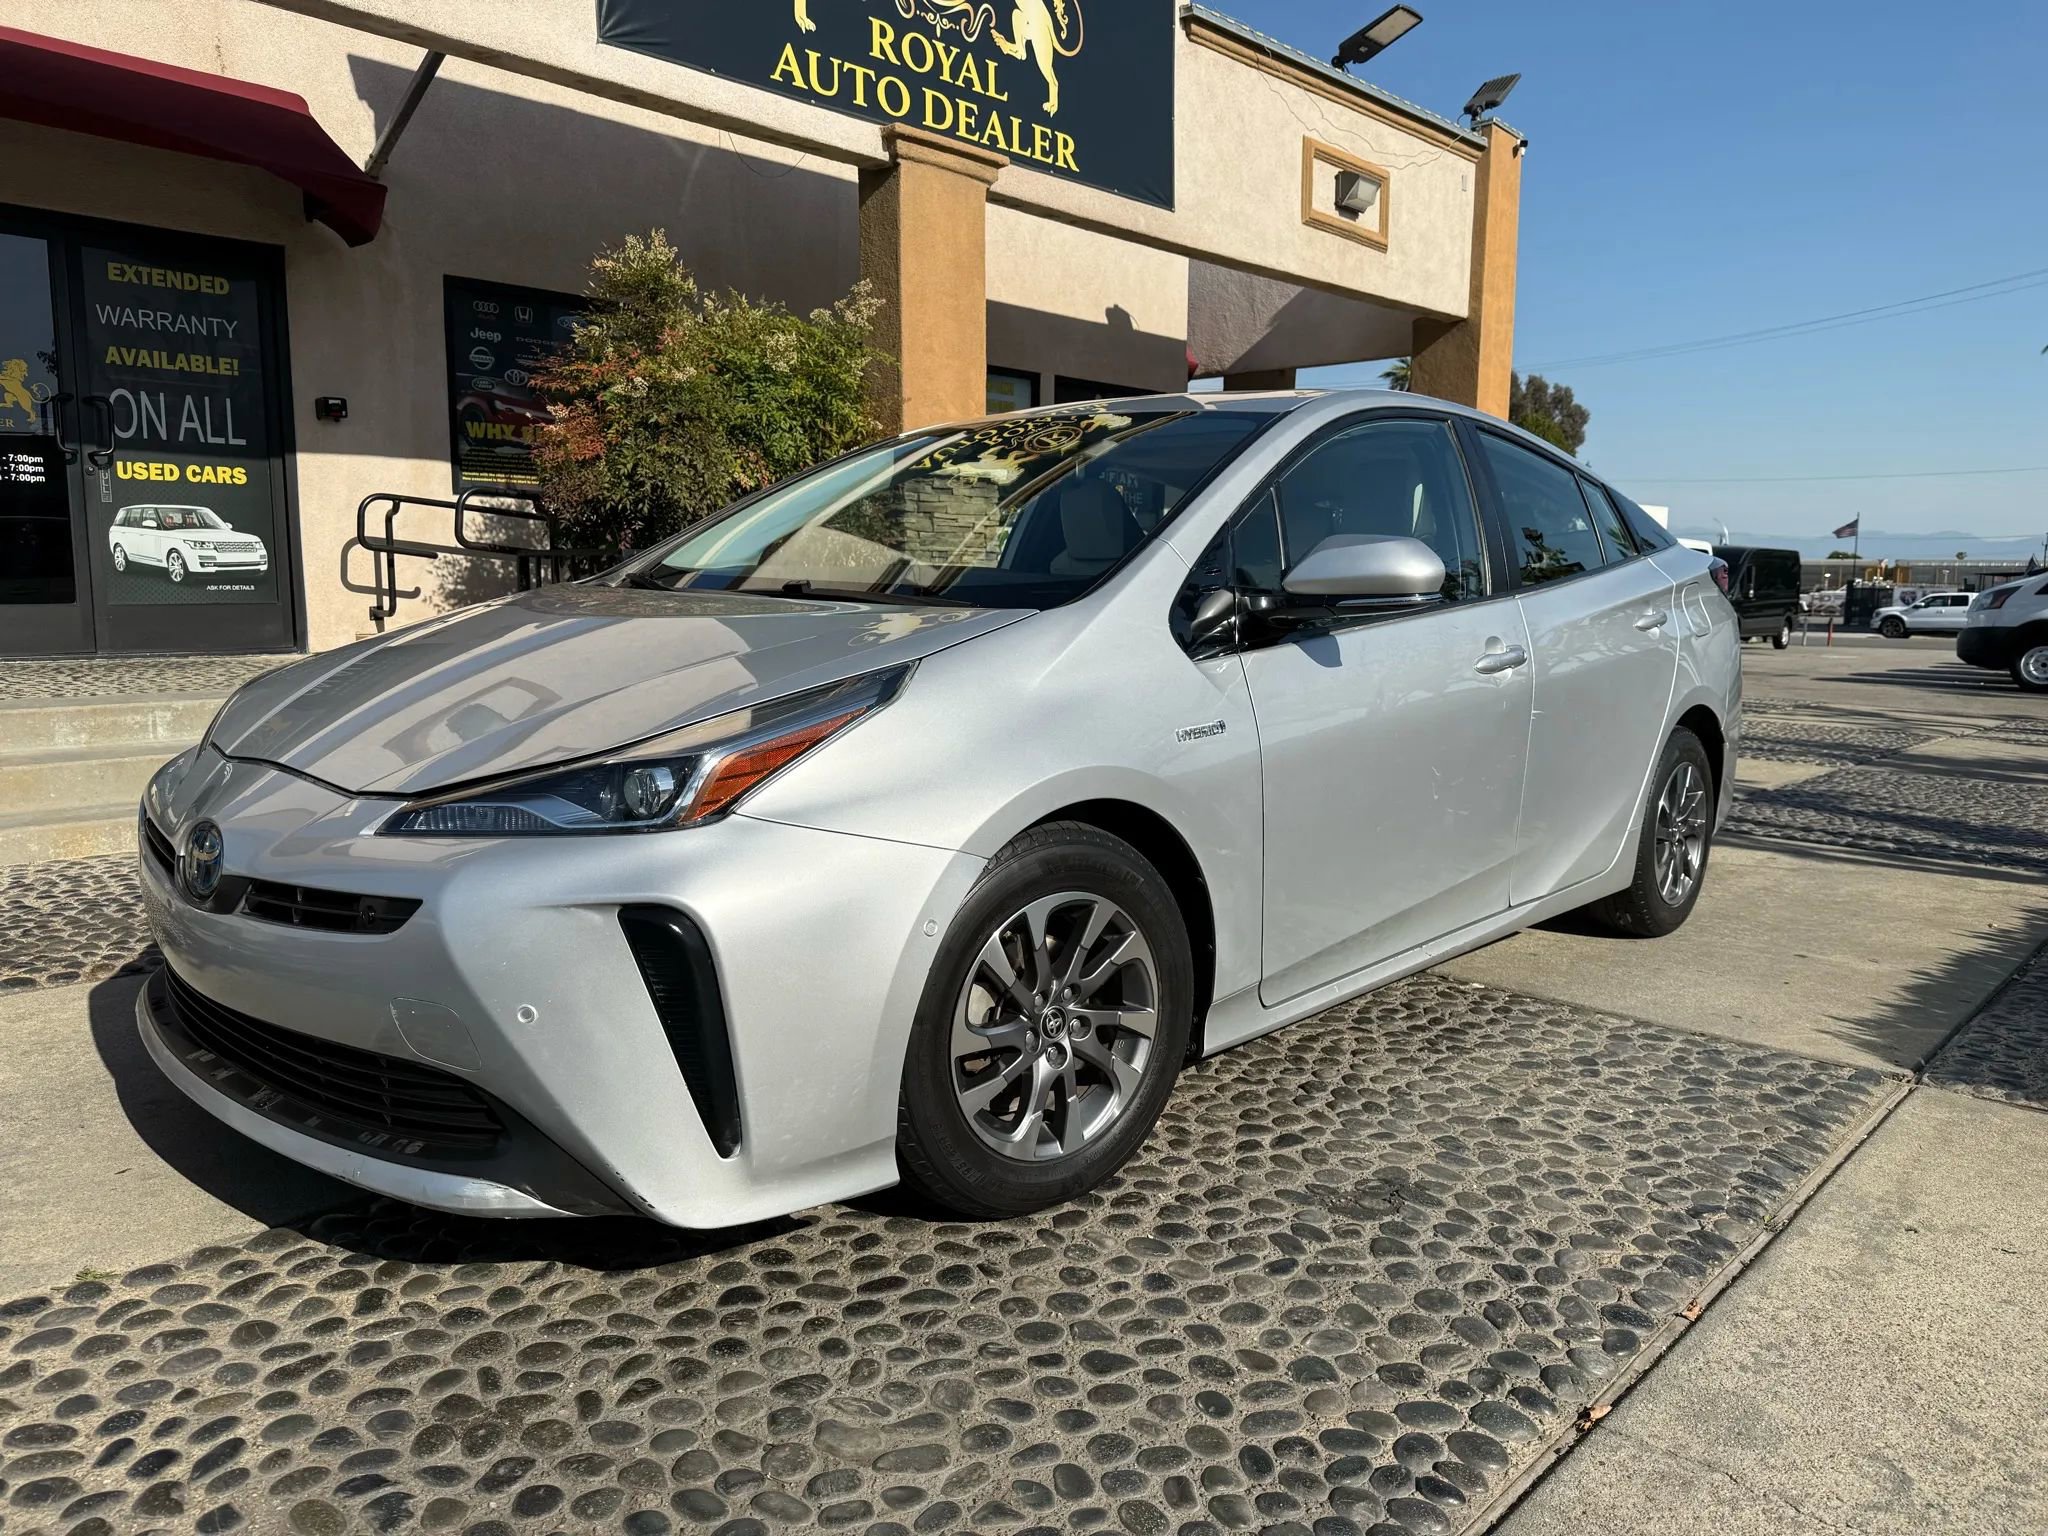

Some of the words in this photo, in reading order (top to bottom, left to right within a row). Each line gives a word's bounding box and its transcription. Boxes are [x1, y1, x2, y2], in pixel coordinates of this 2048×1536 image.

[868, 16, 1009, 102] ROYAL
[769, 42, 911, 118] AUTO
[921, 86, 1080, 173] DEALER
[107, 262, 230, 295] EXTENDED
[95, 303, 238, 339] WARRANTY
[470, 327, 502, 344] Jeep
[105, 345, 239, 376] AVAILABLE!
[108, 387, 168, 441] ON
[179, 395, 247, 446] ALL
[465, 421, 516, 440] WHY
[7, 453, 44, 464] 7:00pm
[9, 463, 45, 474] 7:00pm
[10, 473, 46, 484] 7:00pm
[116, 461, 181, 482] USED
[186, 463, 248, 485] CARS
[1175, 719, 1227, 743] HYBRID
